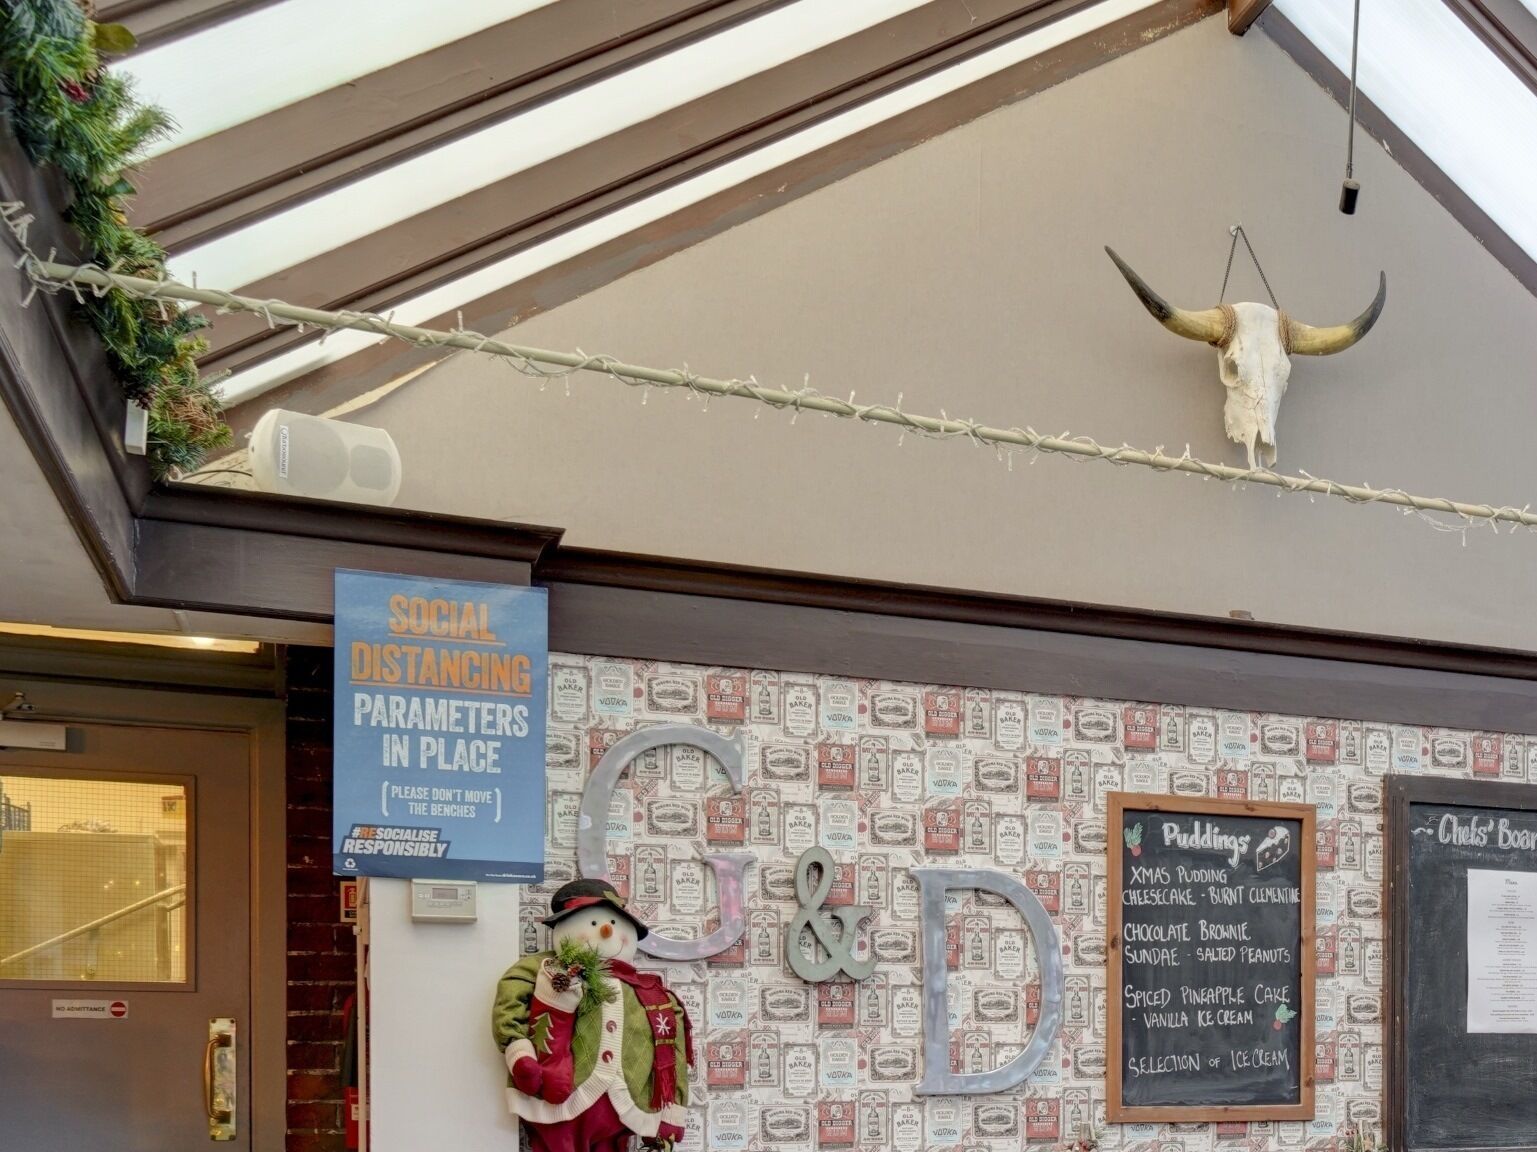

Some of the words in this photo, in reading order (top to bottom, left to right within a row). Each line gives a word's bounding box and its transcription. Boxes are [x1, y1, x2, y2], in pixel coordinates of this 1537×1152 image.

[388, 594, 496, 641] SOCIAL
[351, 641, 531, 693] DISTANCING
[556, 682, 583, 694] BAKER
[598, 696, 628, 707] VODKA
[788, 699, 812, 710] BAKER
[354, 693, 528, 737] PARAMETERS
[826, 712, 853, 722] VODKA
[999, 715, 1021, 725] BAKER
[1034, 727, 1058, 737] VODKA
[382, 734, 409, 767] IN
[420, 736, 501, 774] PLACE
[896, 766, 919, 777] BAKER
[932, 778, 957, 788] VODKA
[391, 785, 429, 800] PLEASE
[432, 788, 462, 802] DON'T
[465, 790, 493, 804] MOVE
[408, 802, 428, 816] THE
[431, 803, 476, 818] BENCHES
[788, 820, 812, 830] BAKER
[351, 826, 438, 842] #RESOCIALISE
[826, 831, 852, 841] VODKA
[998, 830, 1021, 840] BAKER
[343, 839, 447, 858] RESPONSIBLY
[1033, 841, 1058, 850] VODKA
[1162, 820, 1250, 868] Puddings
[1130, 865, 1171, 885] XMAS
[1175, 865, 1227, 884] PUDDING
[675, 876, 700, 886] BAKER
[1122, 887, 1196, 905] CHEESECAKE
[1208, 885, 1244, 906] BURNT
[1249, 887, 1300, 904] CLEMENTINE
[1124, 922, 1191, 942] CHOCOLATE
[1199, 920, 1251, 941] BROWNIE
[998, 945, 1020, 954] BAKER
[1125, 945, 1180, 966] SUNDAE
[1196, 946, 1236, 962] SALTED
[1240, 945, 1291, 963] PEANUTS
[784, 846, 878, 984] &
[909, 865, 1064, 1096] D
[1124, 984, 1171, 1009] SPICED
[1180, 985, 1245, 1005] PINEAPPLE
[1254, 984, 1291, 1005] CAKE
[895, 1001, 918, 1010] BAKER
[715, 1010, 743, 1019] VODKA
[1143, 1010, 1189, 1028] VANILLA
[1198, 1010, 1214, 1027] ICE
[1216, 1009, 1254, 1026] CREAM
[788, 1061, 812, 1070] BAKER
[1128, 1053, 1201, 1078] SELECTION
[1208, 1057, 1221, 1069] OF
[1231, 1050, 1250, 1071] ICE
[1252, 1048, 1290, 1070] CREAM
[826, 1070, 852, 1078] VODKA
[896, 1118, 919, 1128] BAKER
[715, 1132, 743, 1141] VODKA
